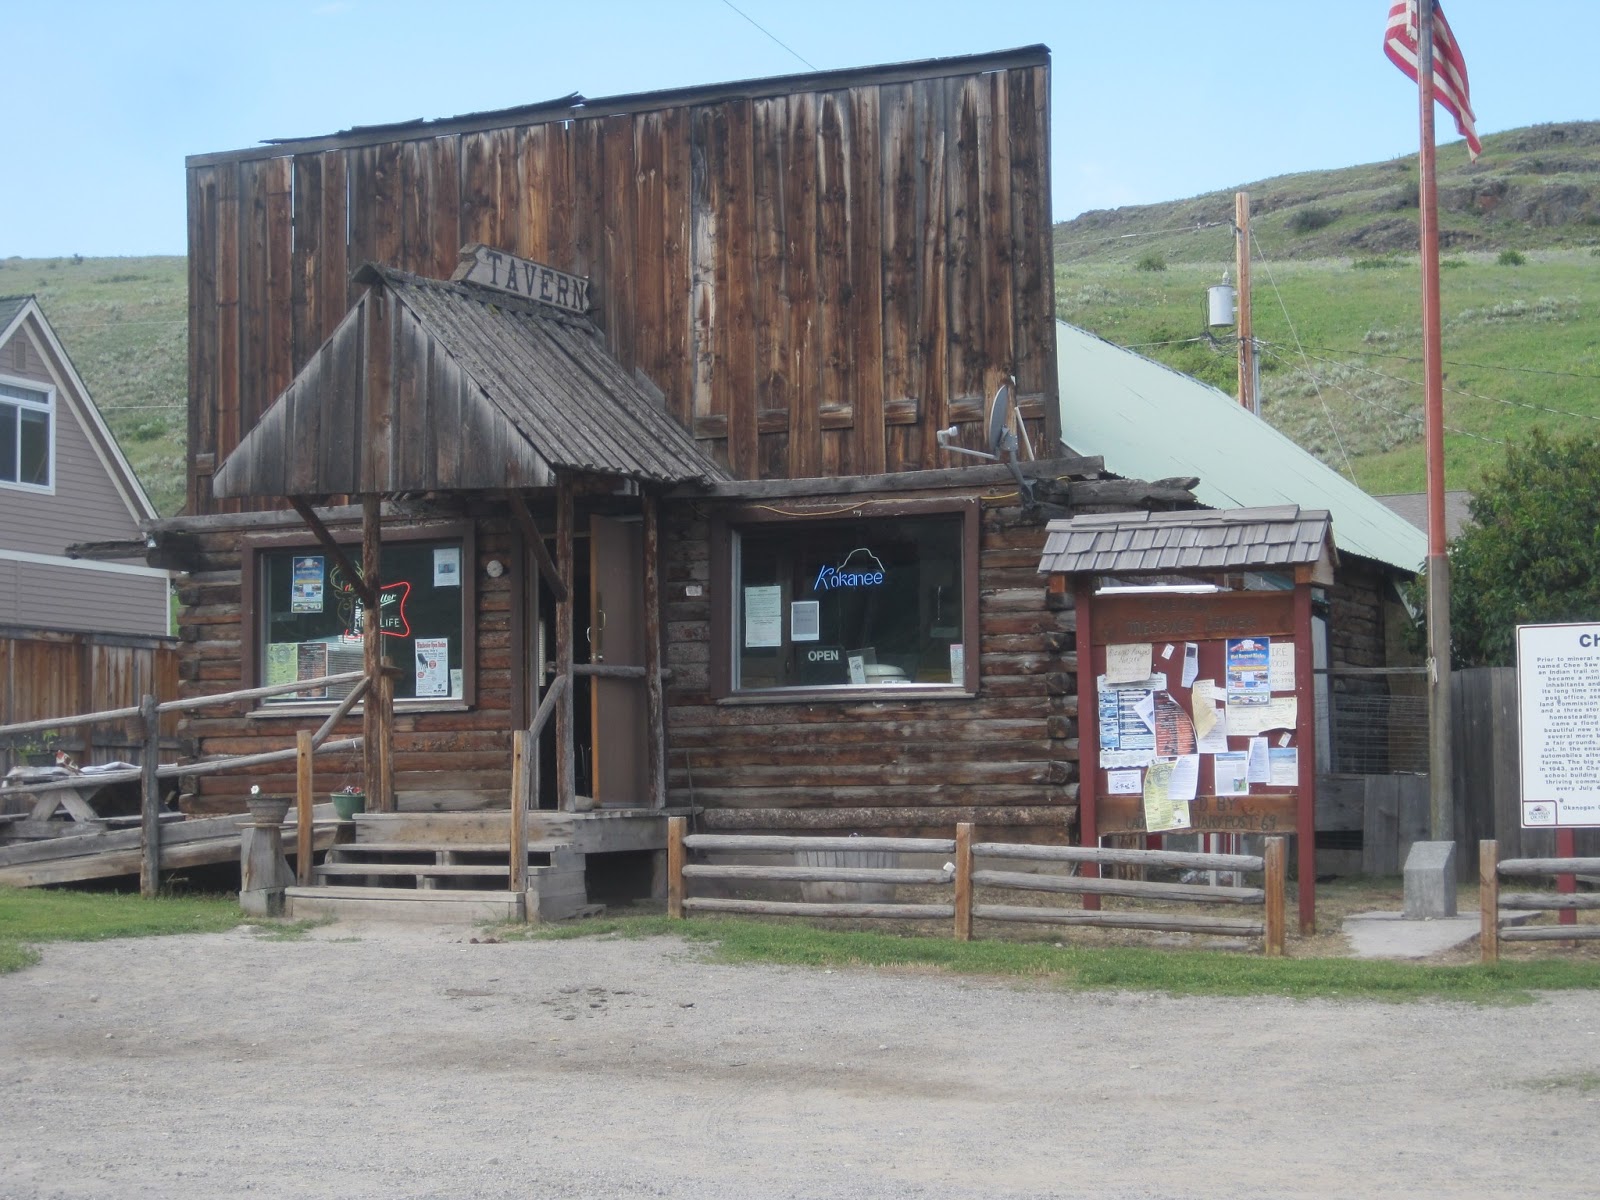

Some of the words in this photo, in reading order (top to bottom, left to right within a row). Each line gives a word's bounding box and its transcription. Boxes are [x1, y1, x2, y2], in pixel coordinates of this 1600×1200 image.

[486, 250, 585, 311] TAVERN
[814, 565, 883, 590] Kokanee
[380, 618, 400, 628] LIFE
[808, 650, 839, 661] OPEN
